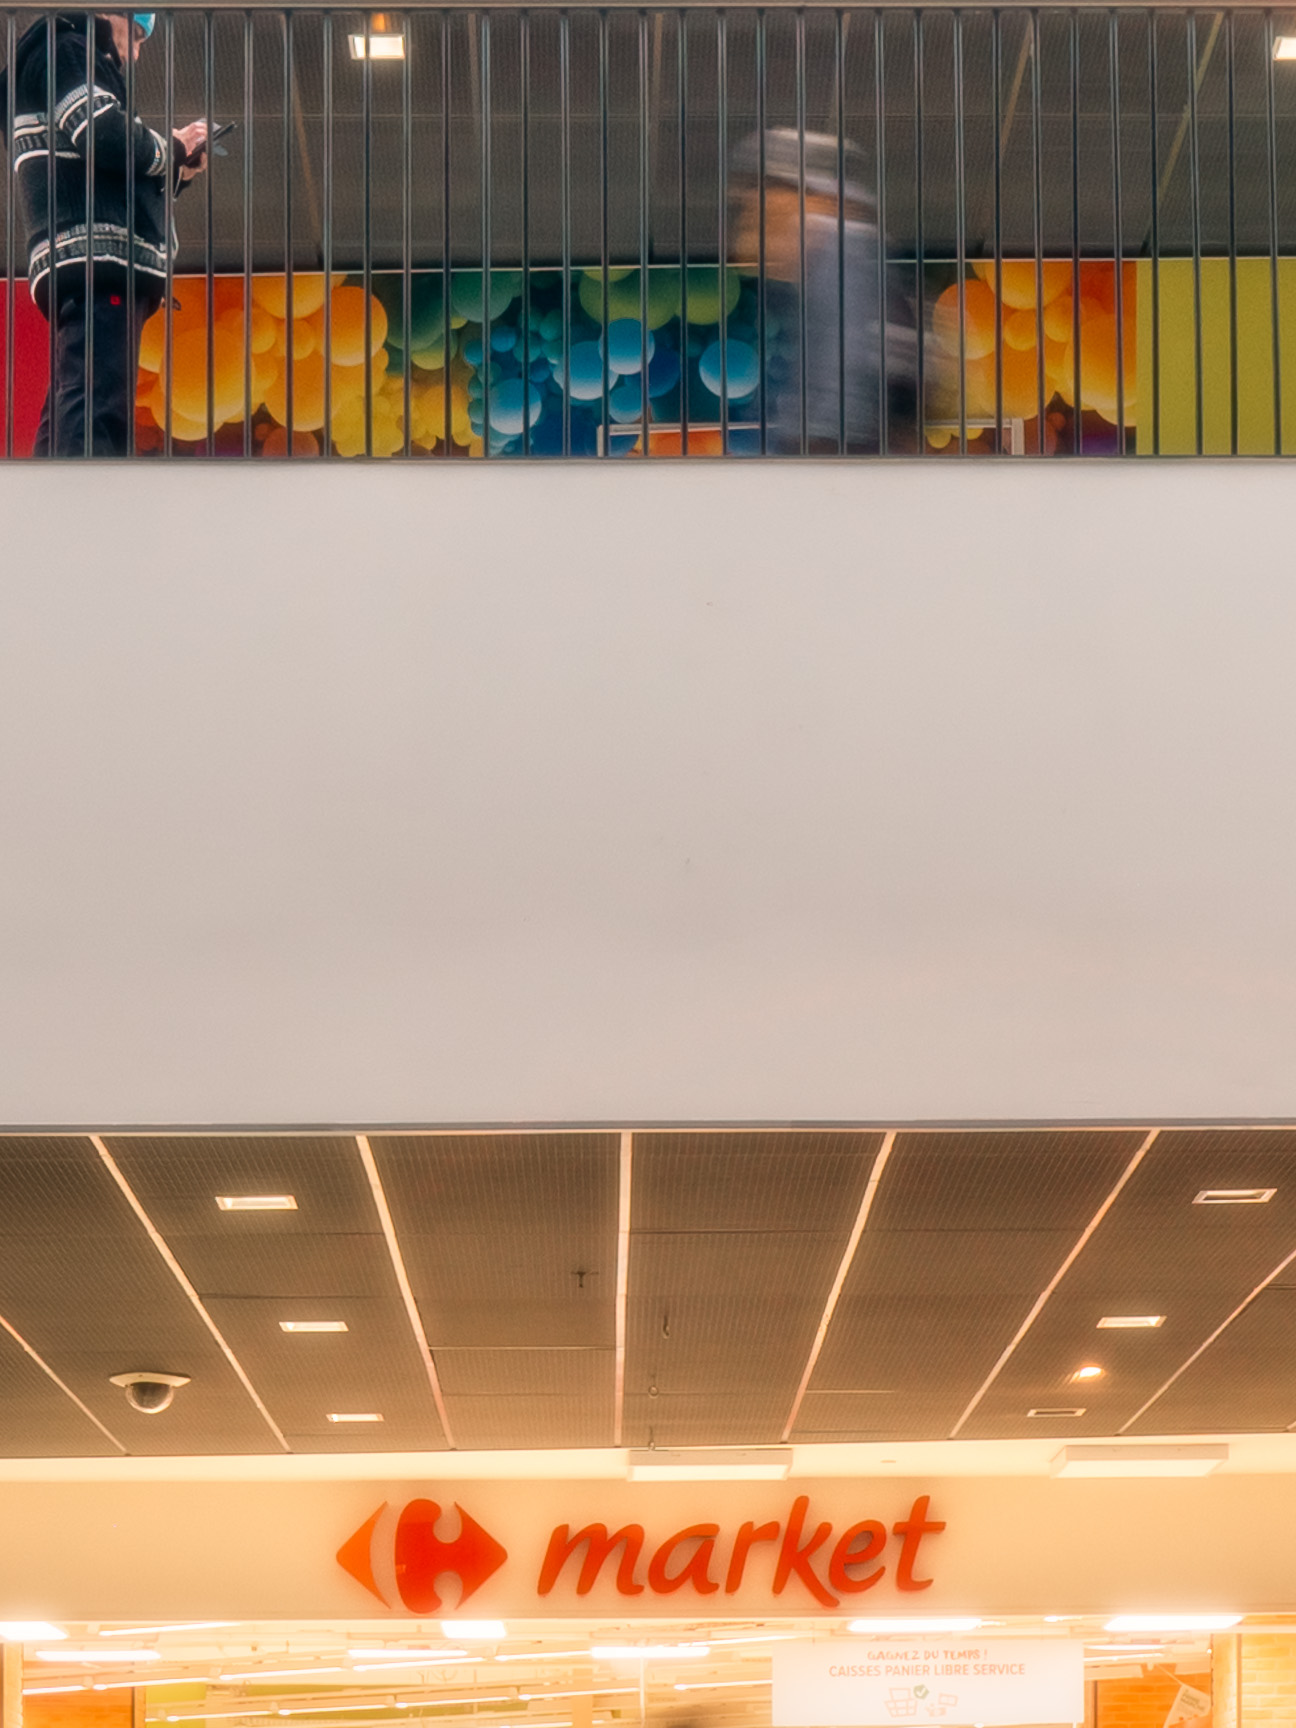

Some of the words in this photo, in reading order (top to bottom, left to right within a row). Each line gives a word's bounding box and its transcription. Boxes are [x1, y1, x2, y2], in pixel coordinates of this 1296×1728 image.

[536, 1494, 946, 1609] market
[867, 1650, 920, 1661] GAGNEZ
[923, 1650, 939, 1660] DU
[943, 1649, 981, 1660] TEMPS
[828, 1664, 882, 1677] CAISSES
[885, 1664, 930, 1676] PANIER
[934, 1663, 970, 1676] LIBRE
[973, 1663, 1027, 1676] SERVICE
